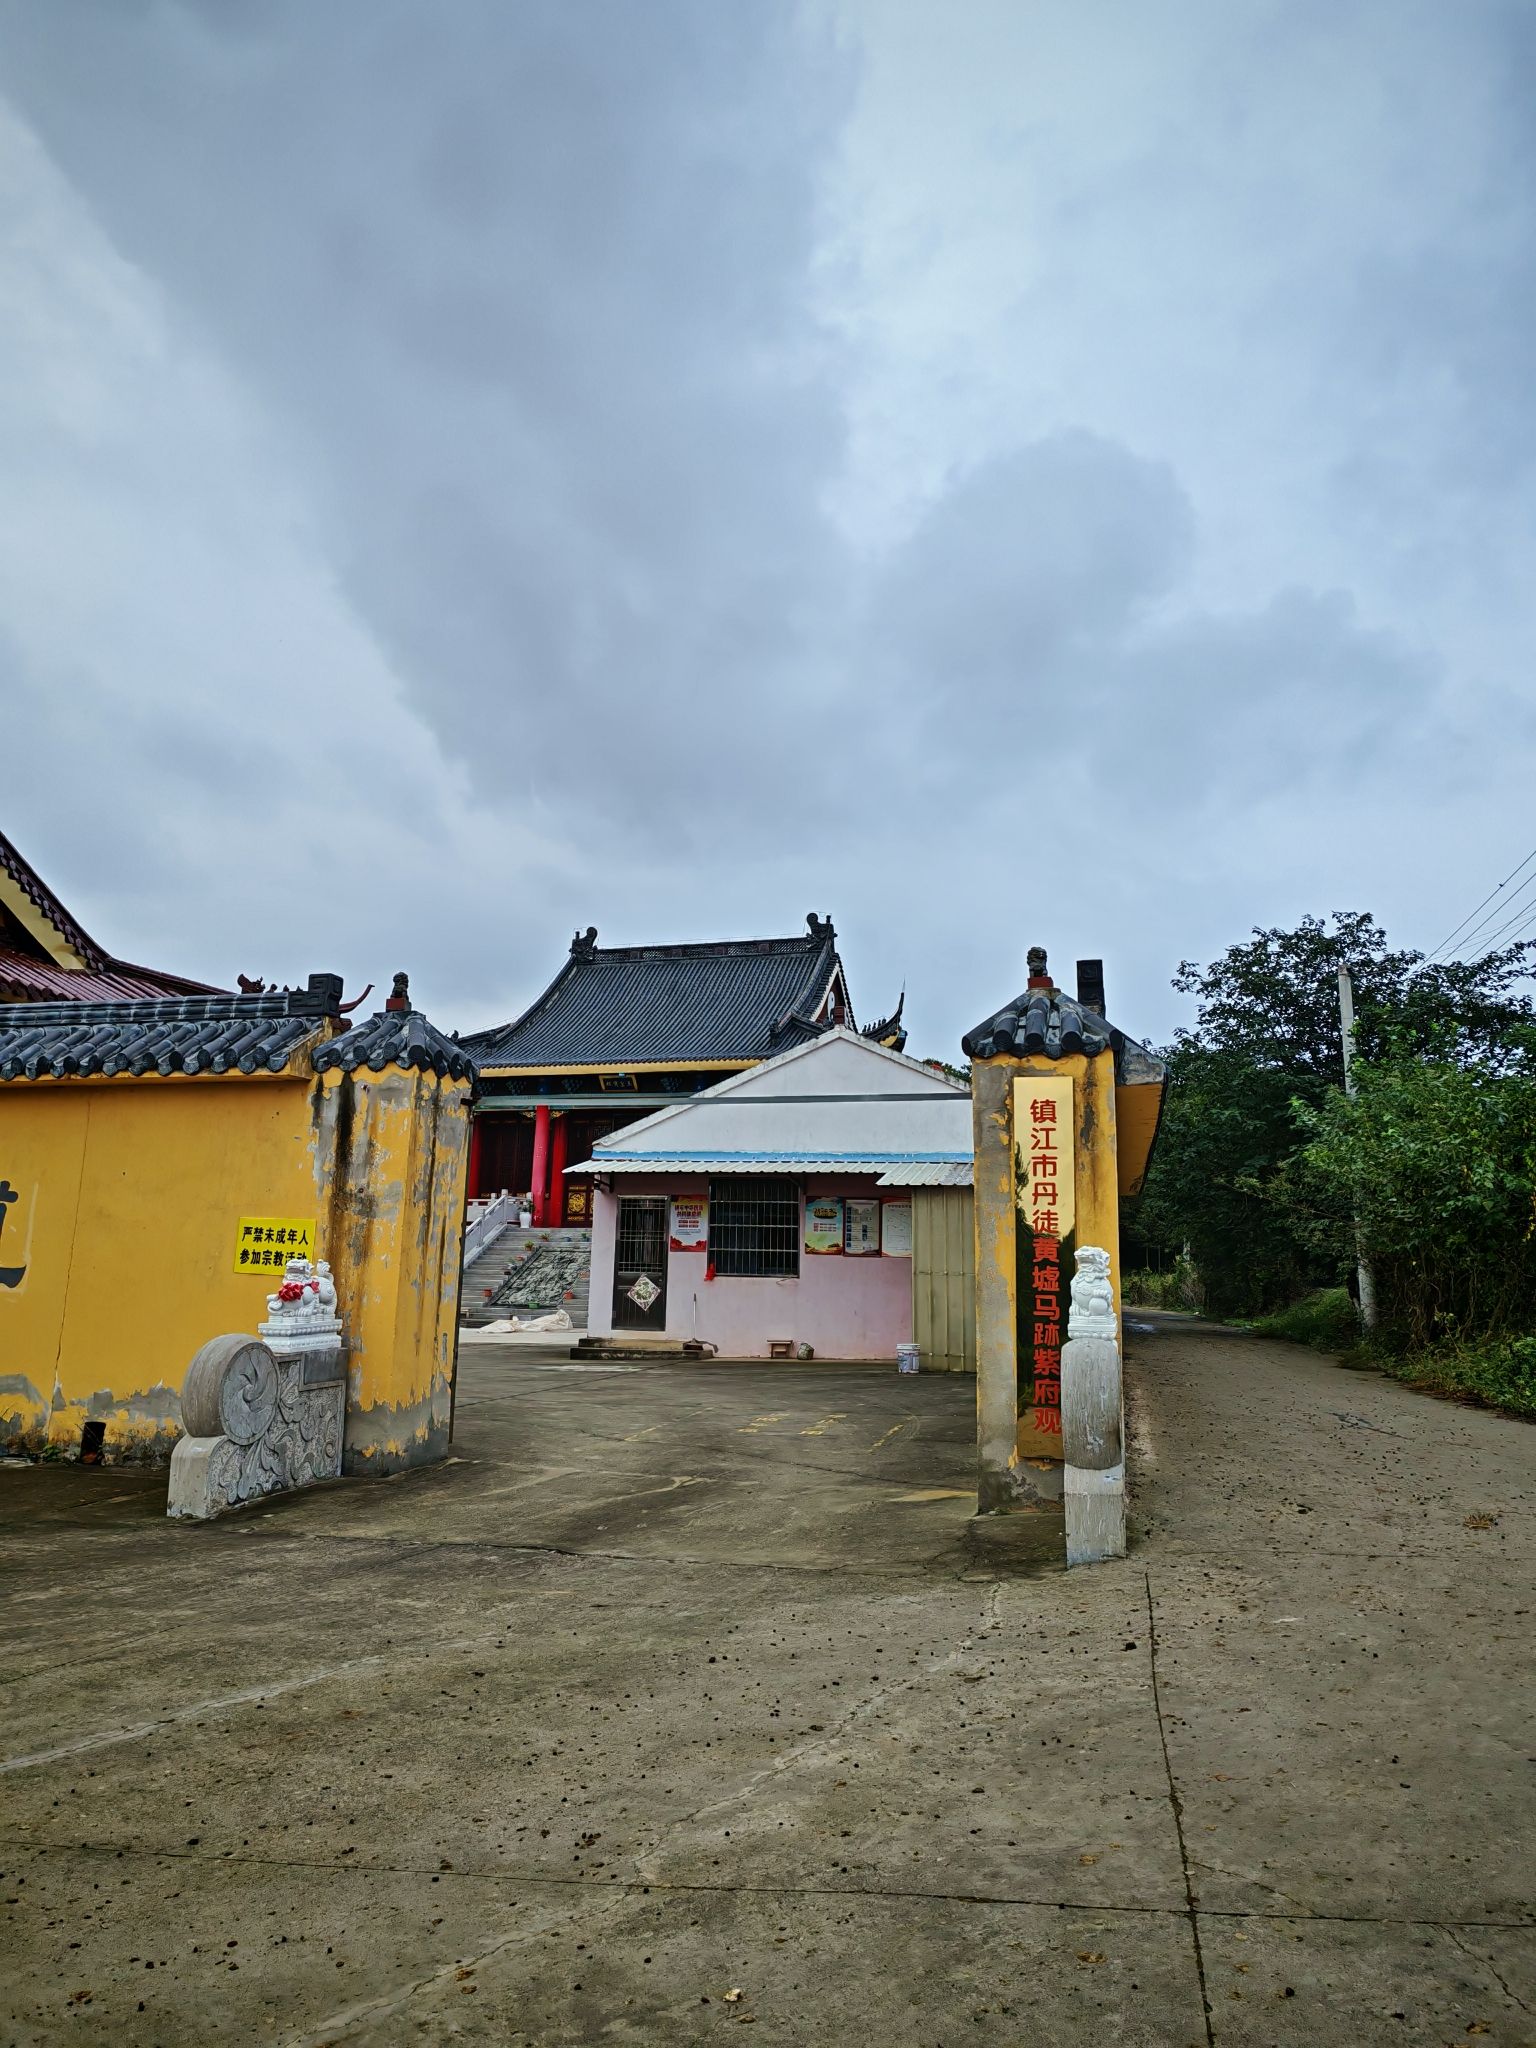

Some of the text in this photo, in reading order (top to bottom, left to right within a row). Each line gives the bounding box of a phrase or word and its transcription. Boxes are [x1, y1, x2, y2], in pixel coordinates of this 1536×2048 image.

[241, 1226, 309, 1245] 严禁未成年人
